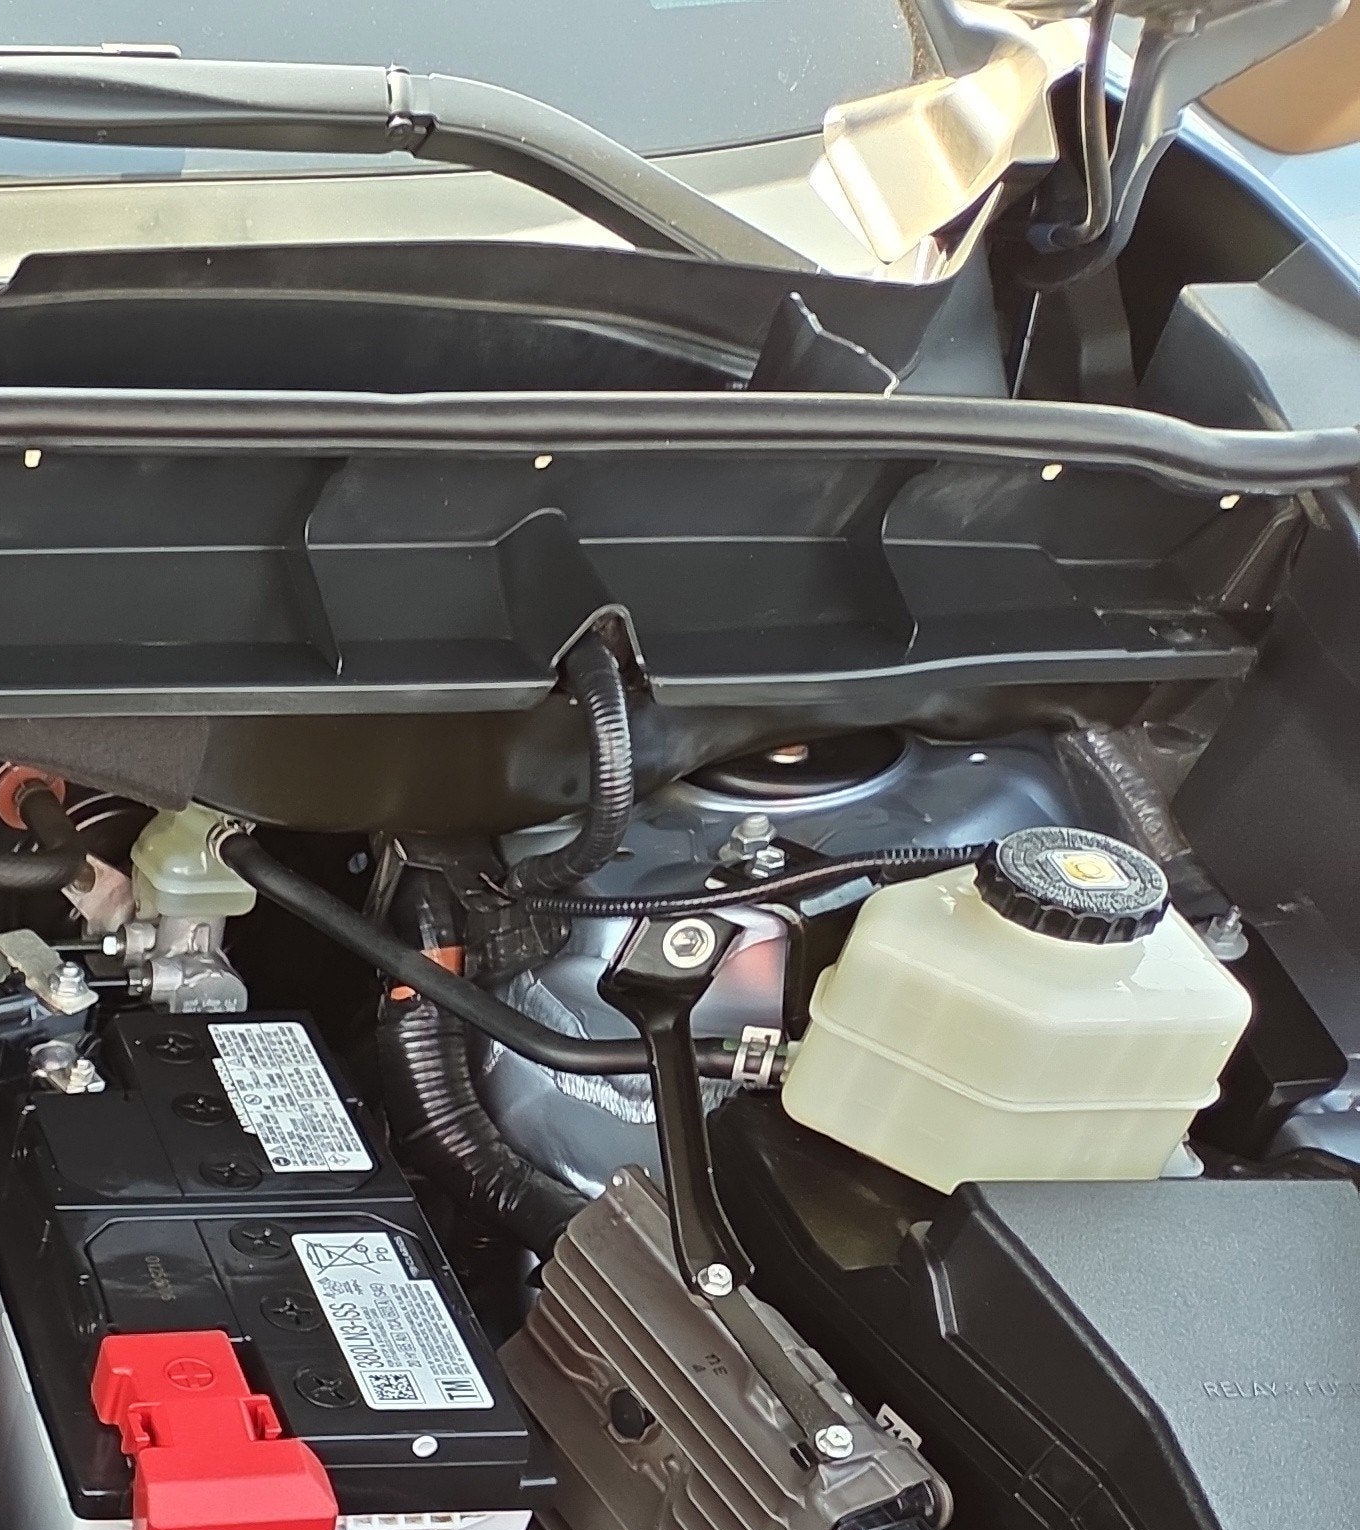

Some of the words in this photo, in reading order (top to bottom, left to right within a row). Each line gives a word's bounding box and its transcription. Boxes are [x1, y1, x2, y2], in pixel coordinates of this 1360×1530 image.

[374, 1246, 392, 1261] Pb
[443, 1380, 477, 1400] TM
[1202, 1380, 1279, 1397] RELAY
